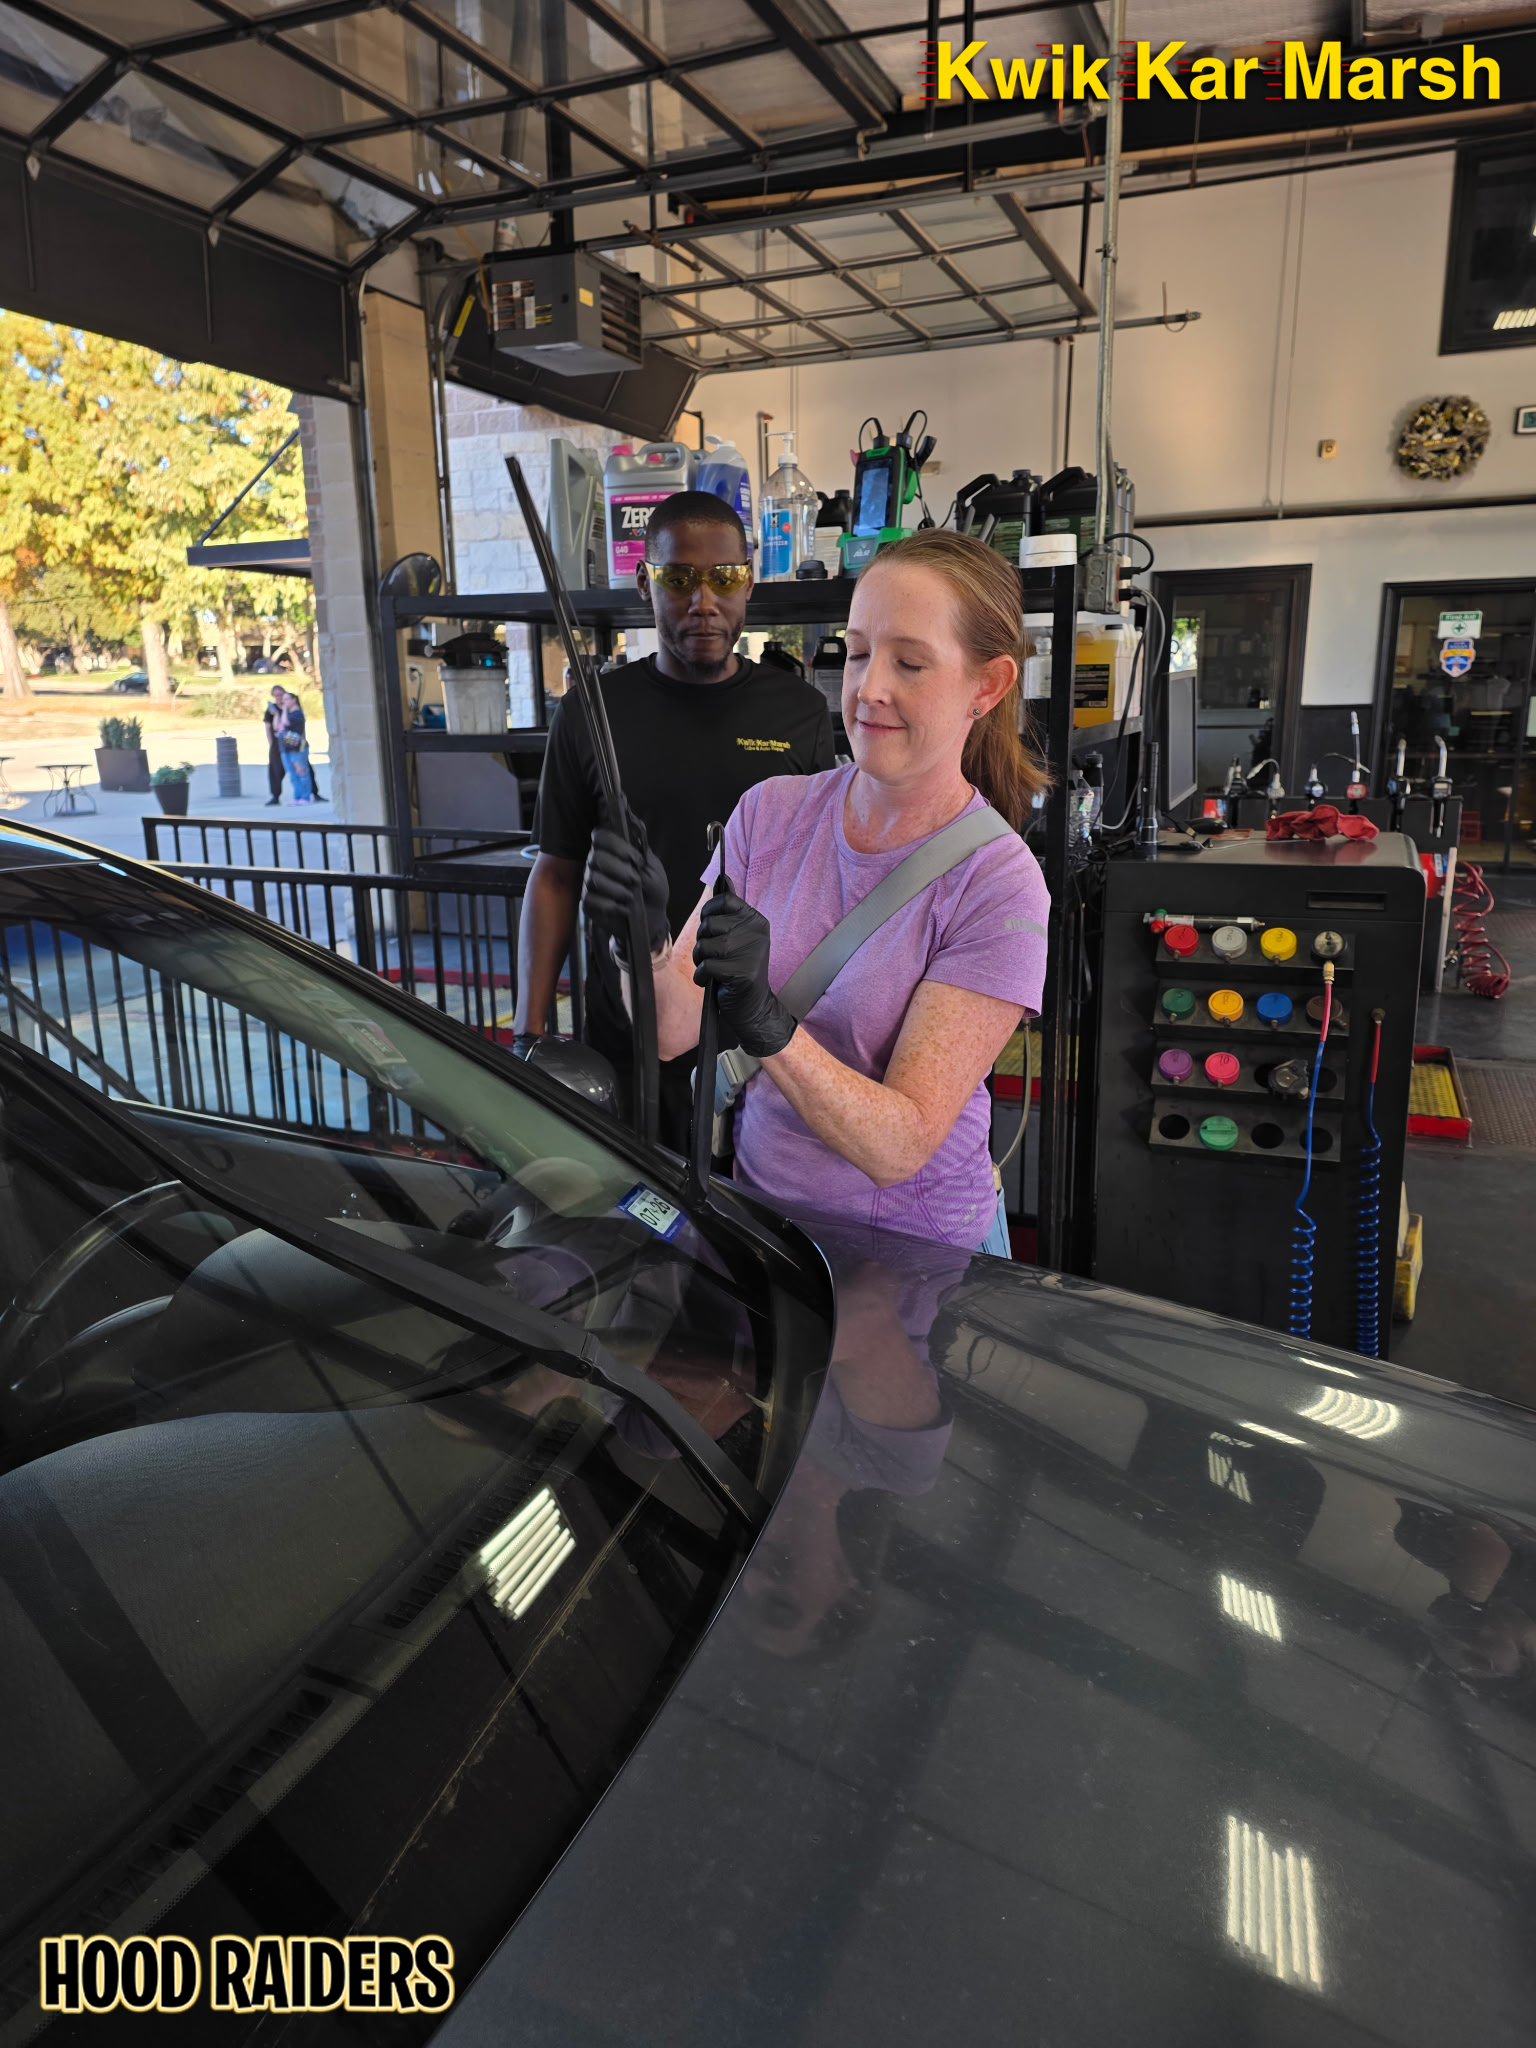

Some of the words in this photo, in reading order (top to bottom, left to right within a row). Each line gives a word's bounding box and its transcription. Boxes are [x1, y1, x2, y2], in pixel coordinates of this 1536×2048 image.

[620, 505, 657, 529] ZER
[736, 738, 756, 746] Kwik
[756, 739, 769, 747] Kar
[769, 739, 791, 749] Marsh
